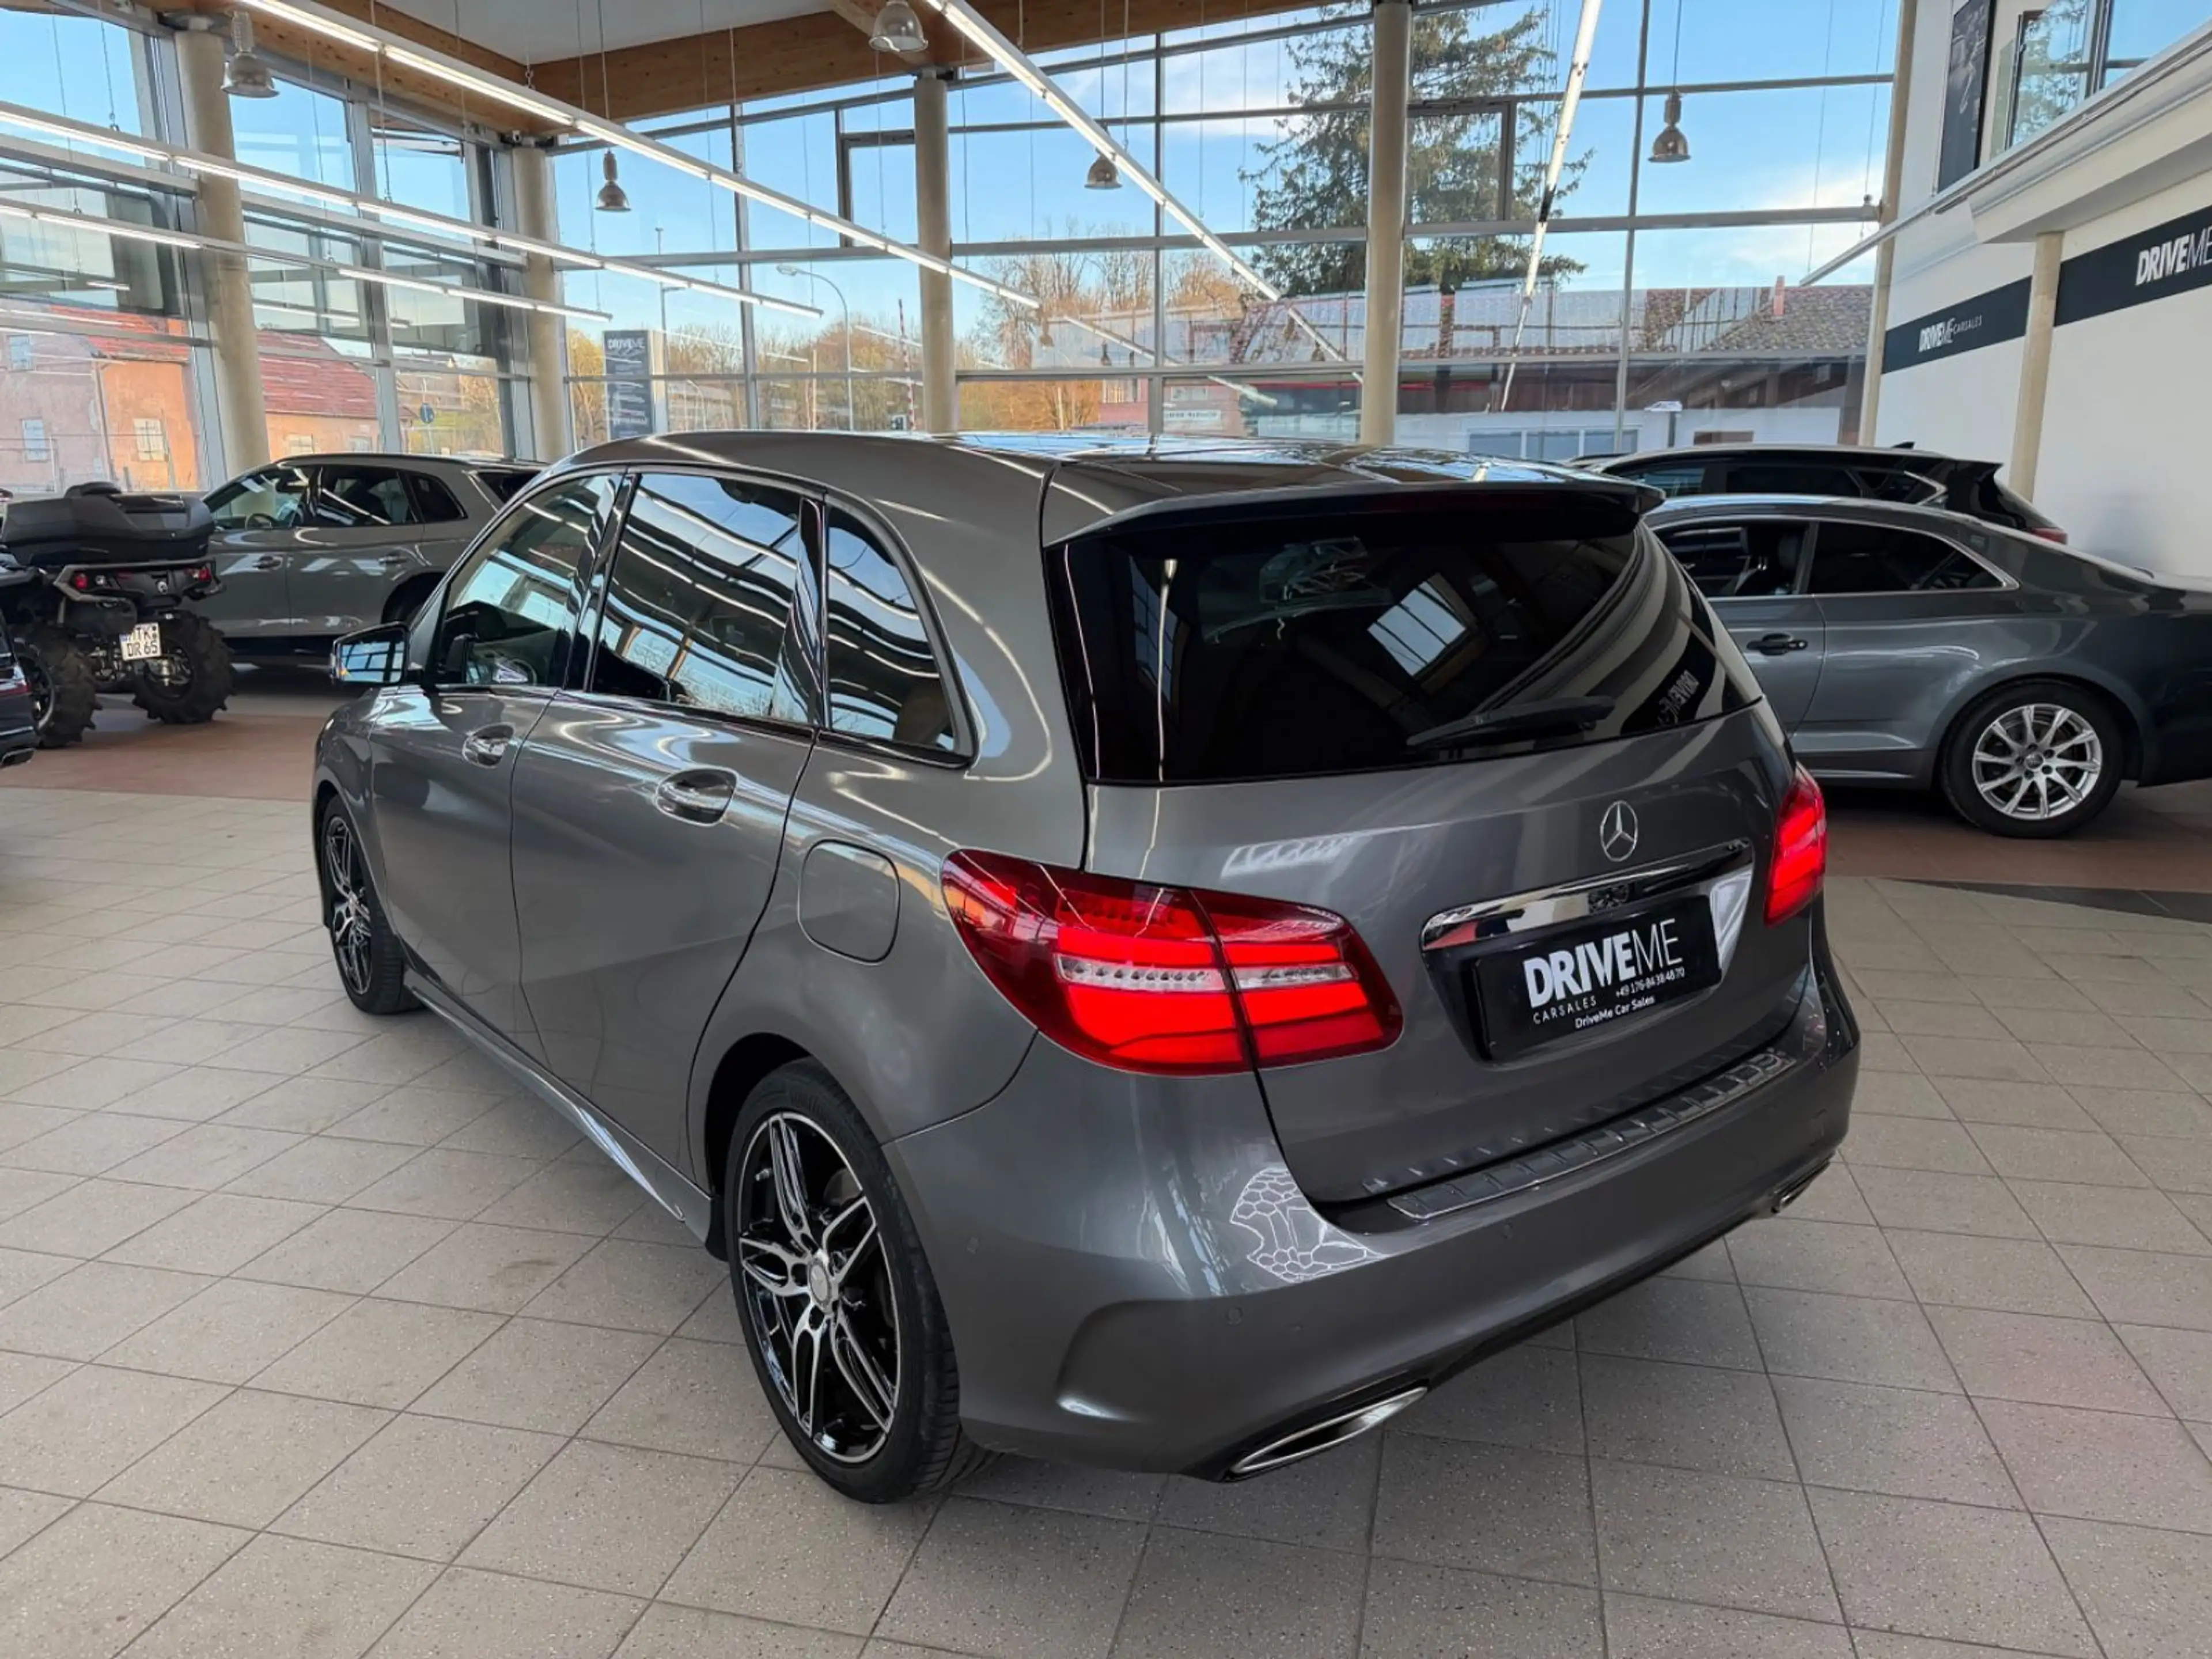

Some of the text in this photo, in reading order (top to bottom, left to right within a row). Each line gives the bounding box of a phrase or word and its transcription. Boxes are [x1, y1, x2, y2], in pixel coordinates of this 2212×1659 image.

[1523, 918, 1683, 1008] DRIVEME
[1533, 995, 1597, 1025] CARSALES
[1615, 1004, 1630, 1016] Car
[1631, 995, 1656, 1011] Sales
